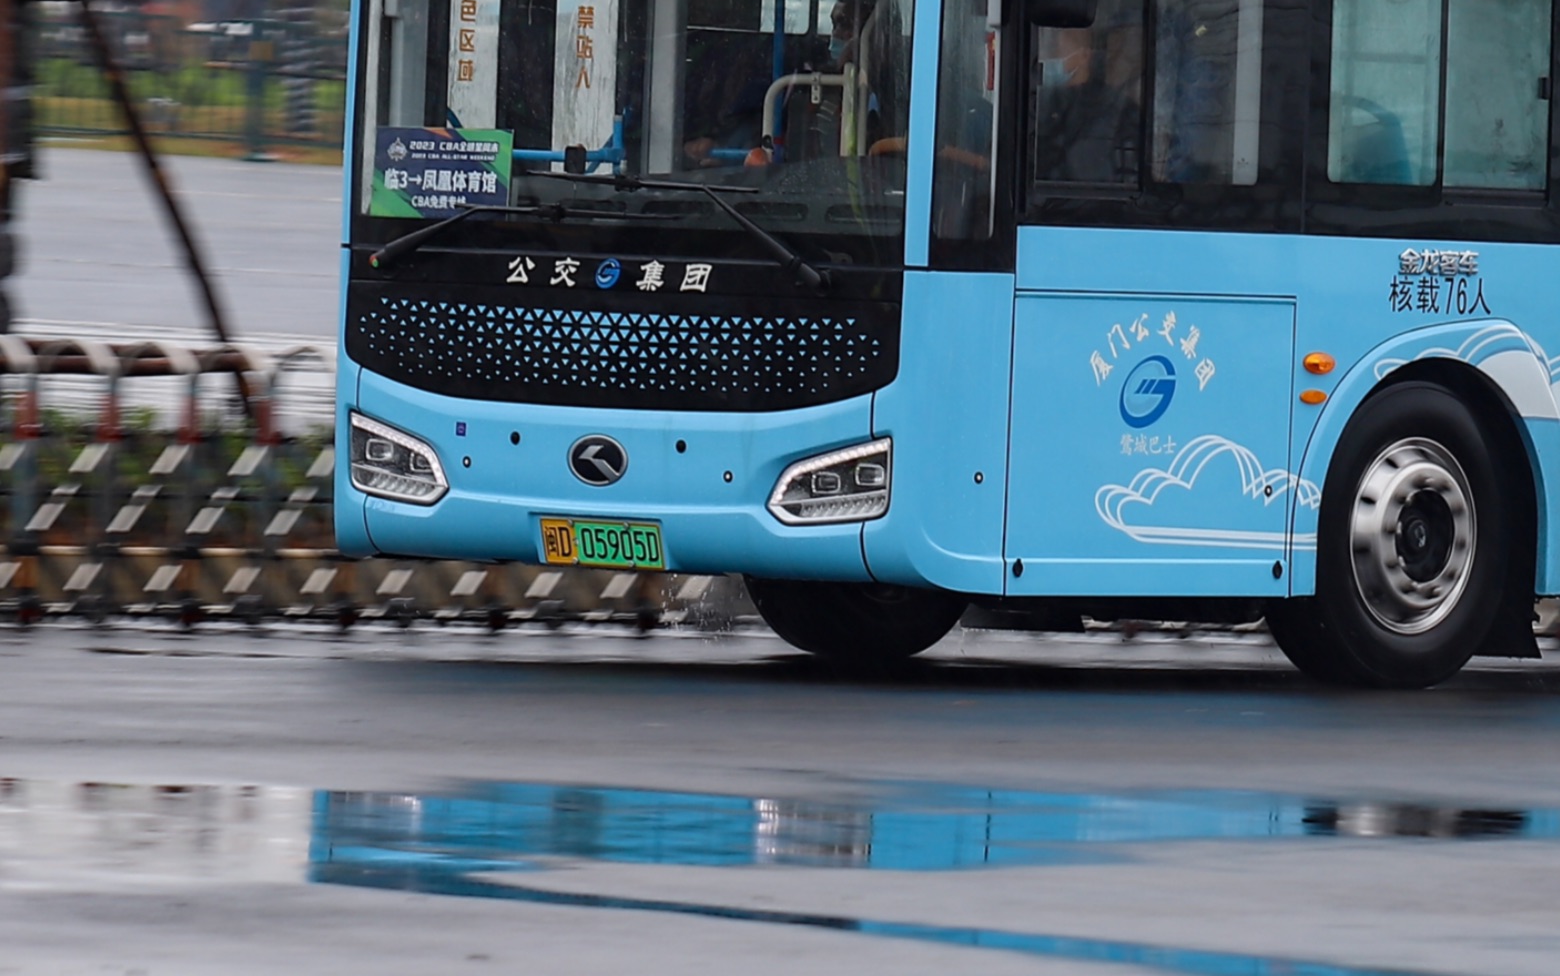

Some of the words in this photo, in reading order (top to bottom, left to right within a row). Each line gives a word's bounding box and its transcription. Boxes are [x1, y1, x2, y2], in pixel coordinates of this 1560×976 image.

[409, 140, 435, 151] 2023
[384, 168, 408, 190] 临3
[422, 168, 497, 194] 凤凰体育馆
[1398, 247, 1480, 277] 金龙客车
